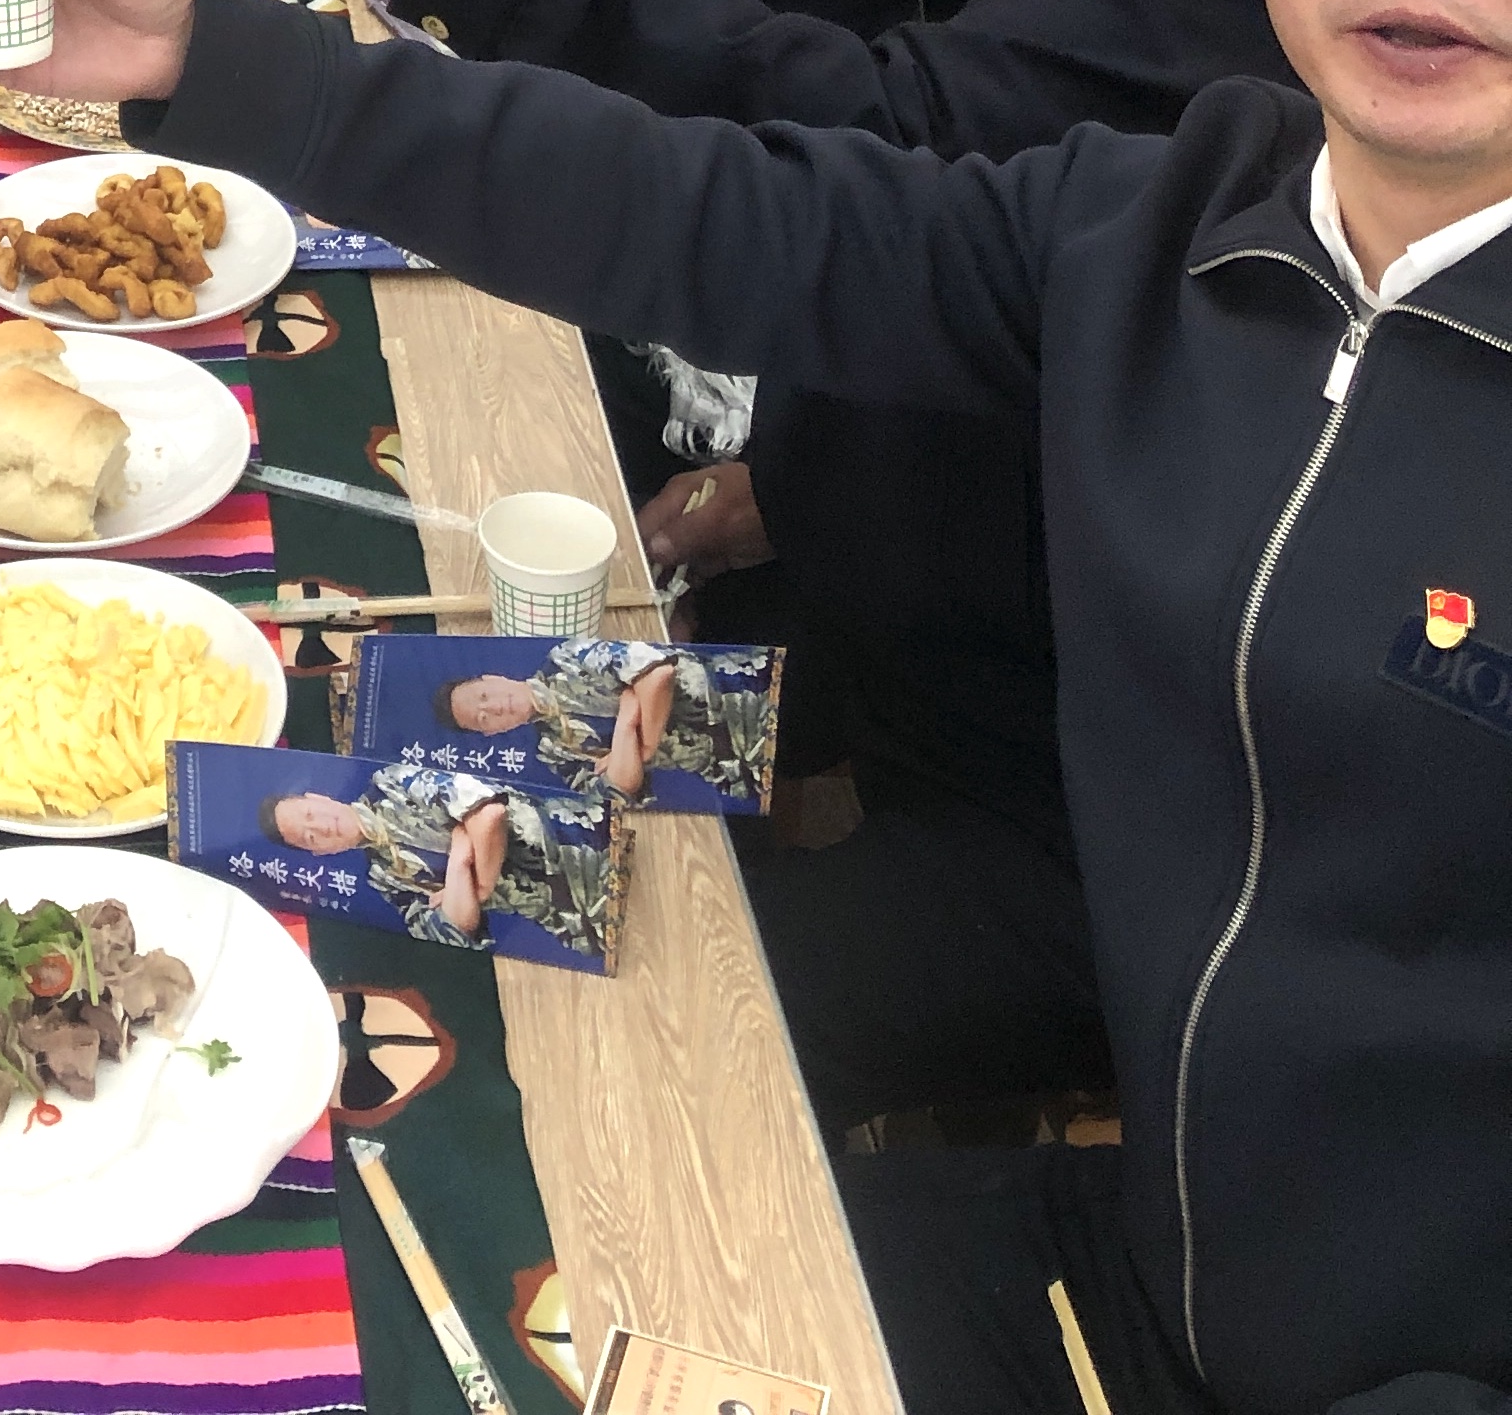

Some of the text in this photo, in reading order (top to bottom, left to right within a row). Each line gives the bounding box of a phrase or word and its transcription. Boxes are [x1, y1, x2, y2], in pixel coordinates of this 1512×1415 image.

[401, 741, 527, 774] 洛桑尖措
[228, 851, 358, 897] 洛桑尖措
